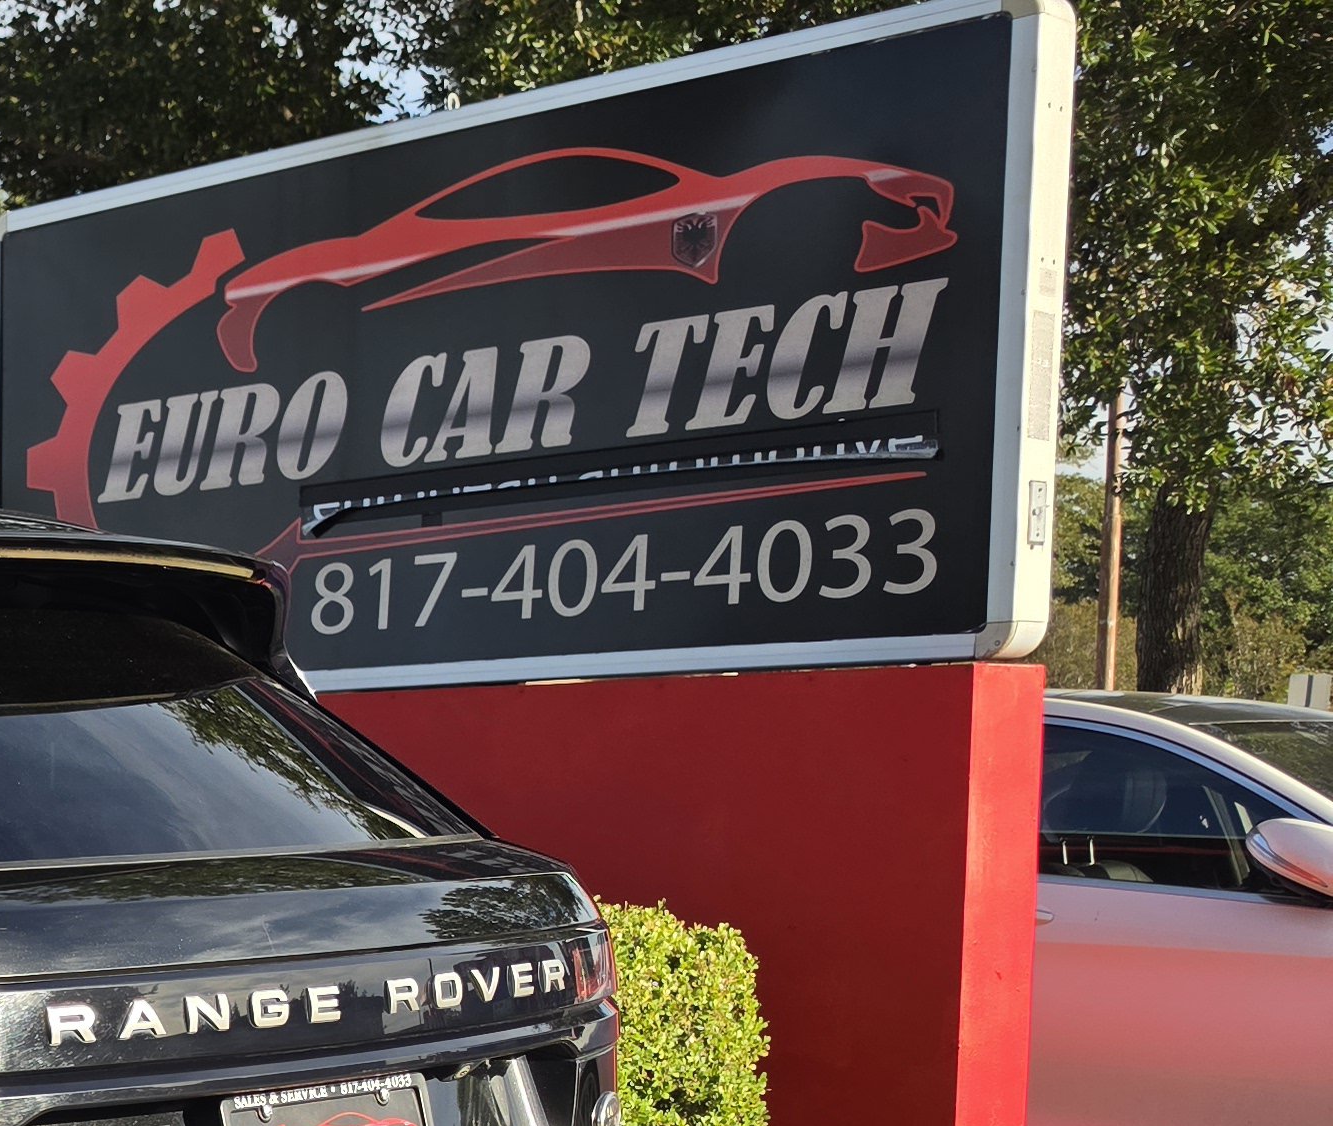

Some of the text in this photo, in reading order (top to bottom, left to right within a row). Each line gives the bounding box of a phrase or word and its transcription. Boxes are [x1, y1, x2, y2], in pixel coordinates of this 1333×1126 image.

[98, 371, 347, 503] EURO
[379, 334, 592, 468] CAR
[626, 277, 950, 439] TECH
[310, 507, 938, 636] 817-404-4033
[47, 958, 566, 1046] RANGE ROVER
[233, 1093, 267, 1109] SALES
[268, 1091, 280, 1104] &
